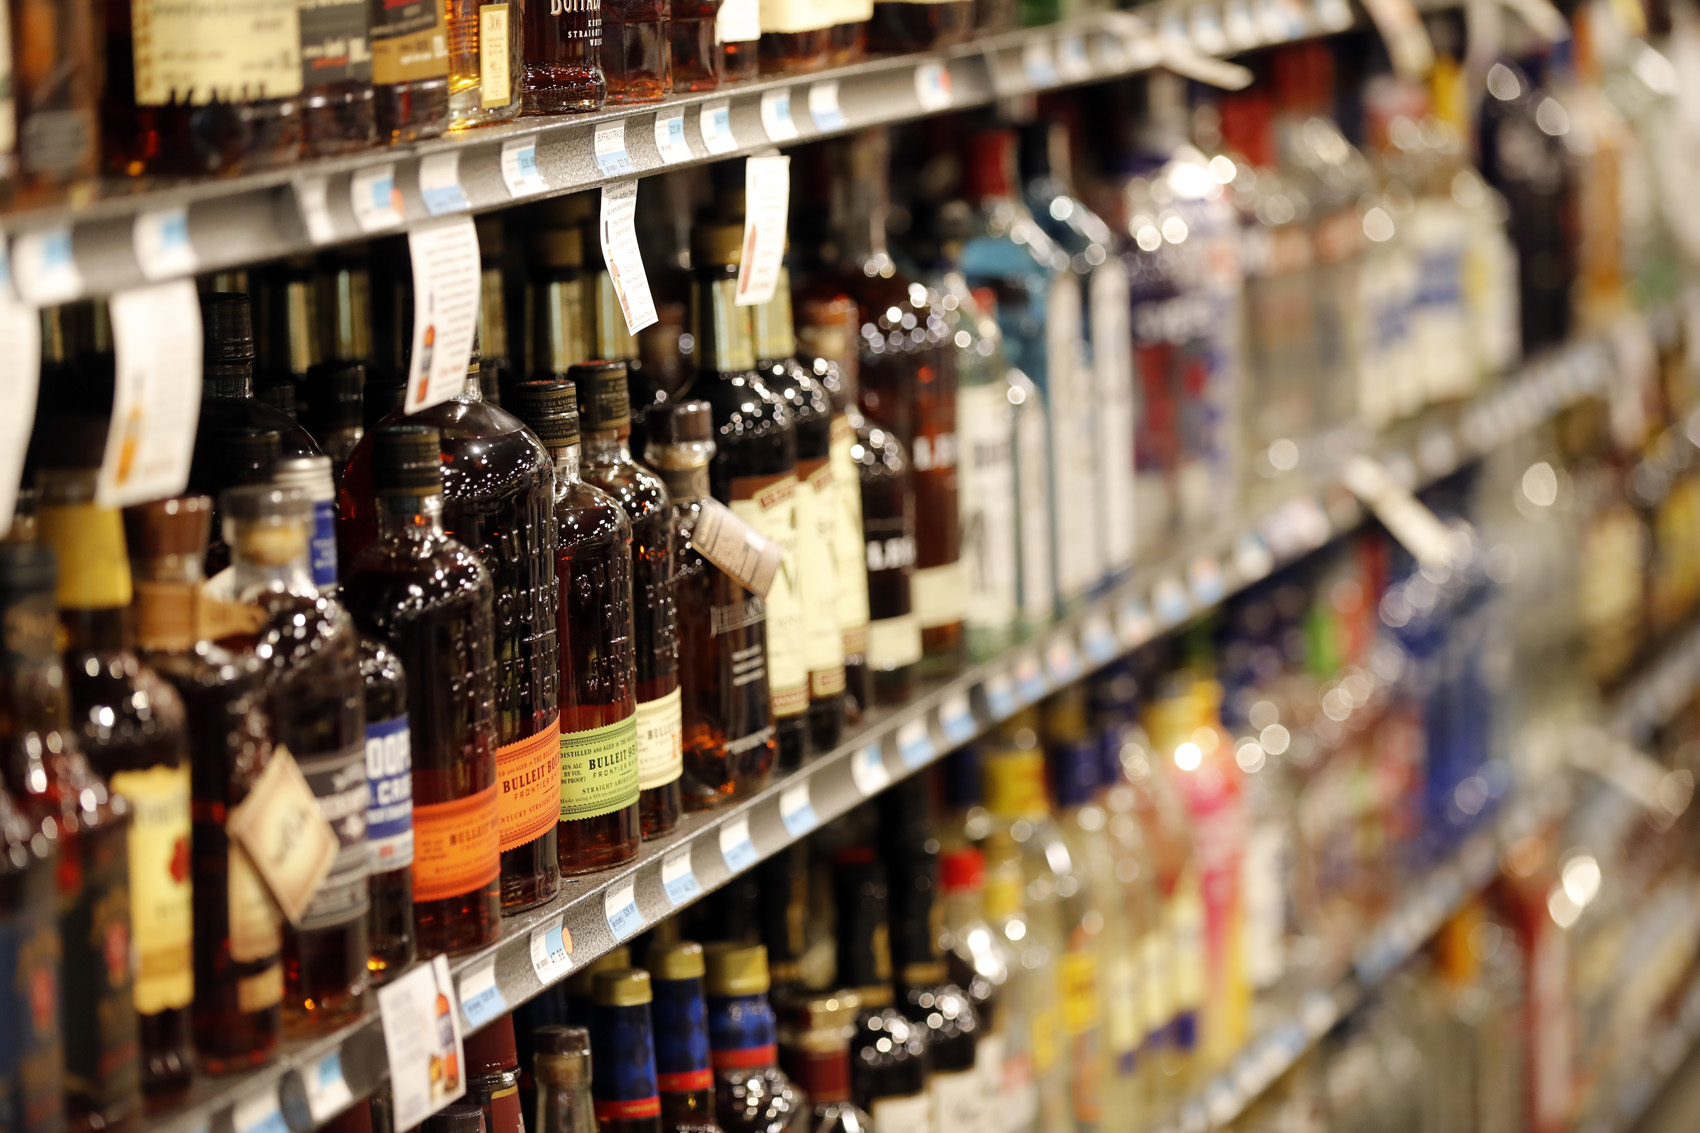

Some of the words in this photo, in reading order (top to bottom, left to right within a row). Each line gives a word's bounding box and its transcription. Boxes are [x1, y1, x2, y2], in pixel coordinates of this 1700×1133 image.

[603, 743, 615, 751] AGED
[588, 749, 627, 771] BULLEIT
[503, 764, 546, 794] BULLEIT
[592, 763, 627, 780] FRONTIER
[514, 777, 550, 801] FRONTIER
[582, 782, 613, 795] STRAIGHT
